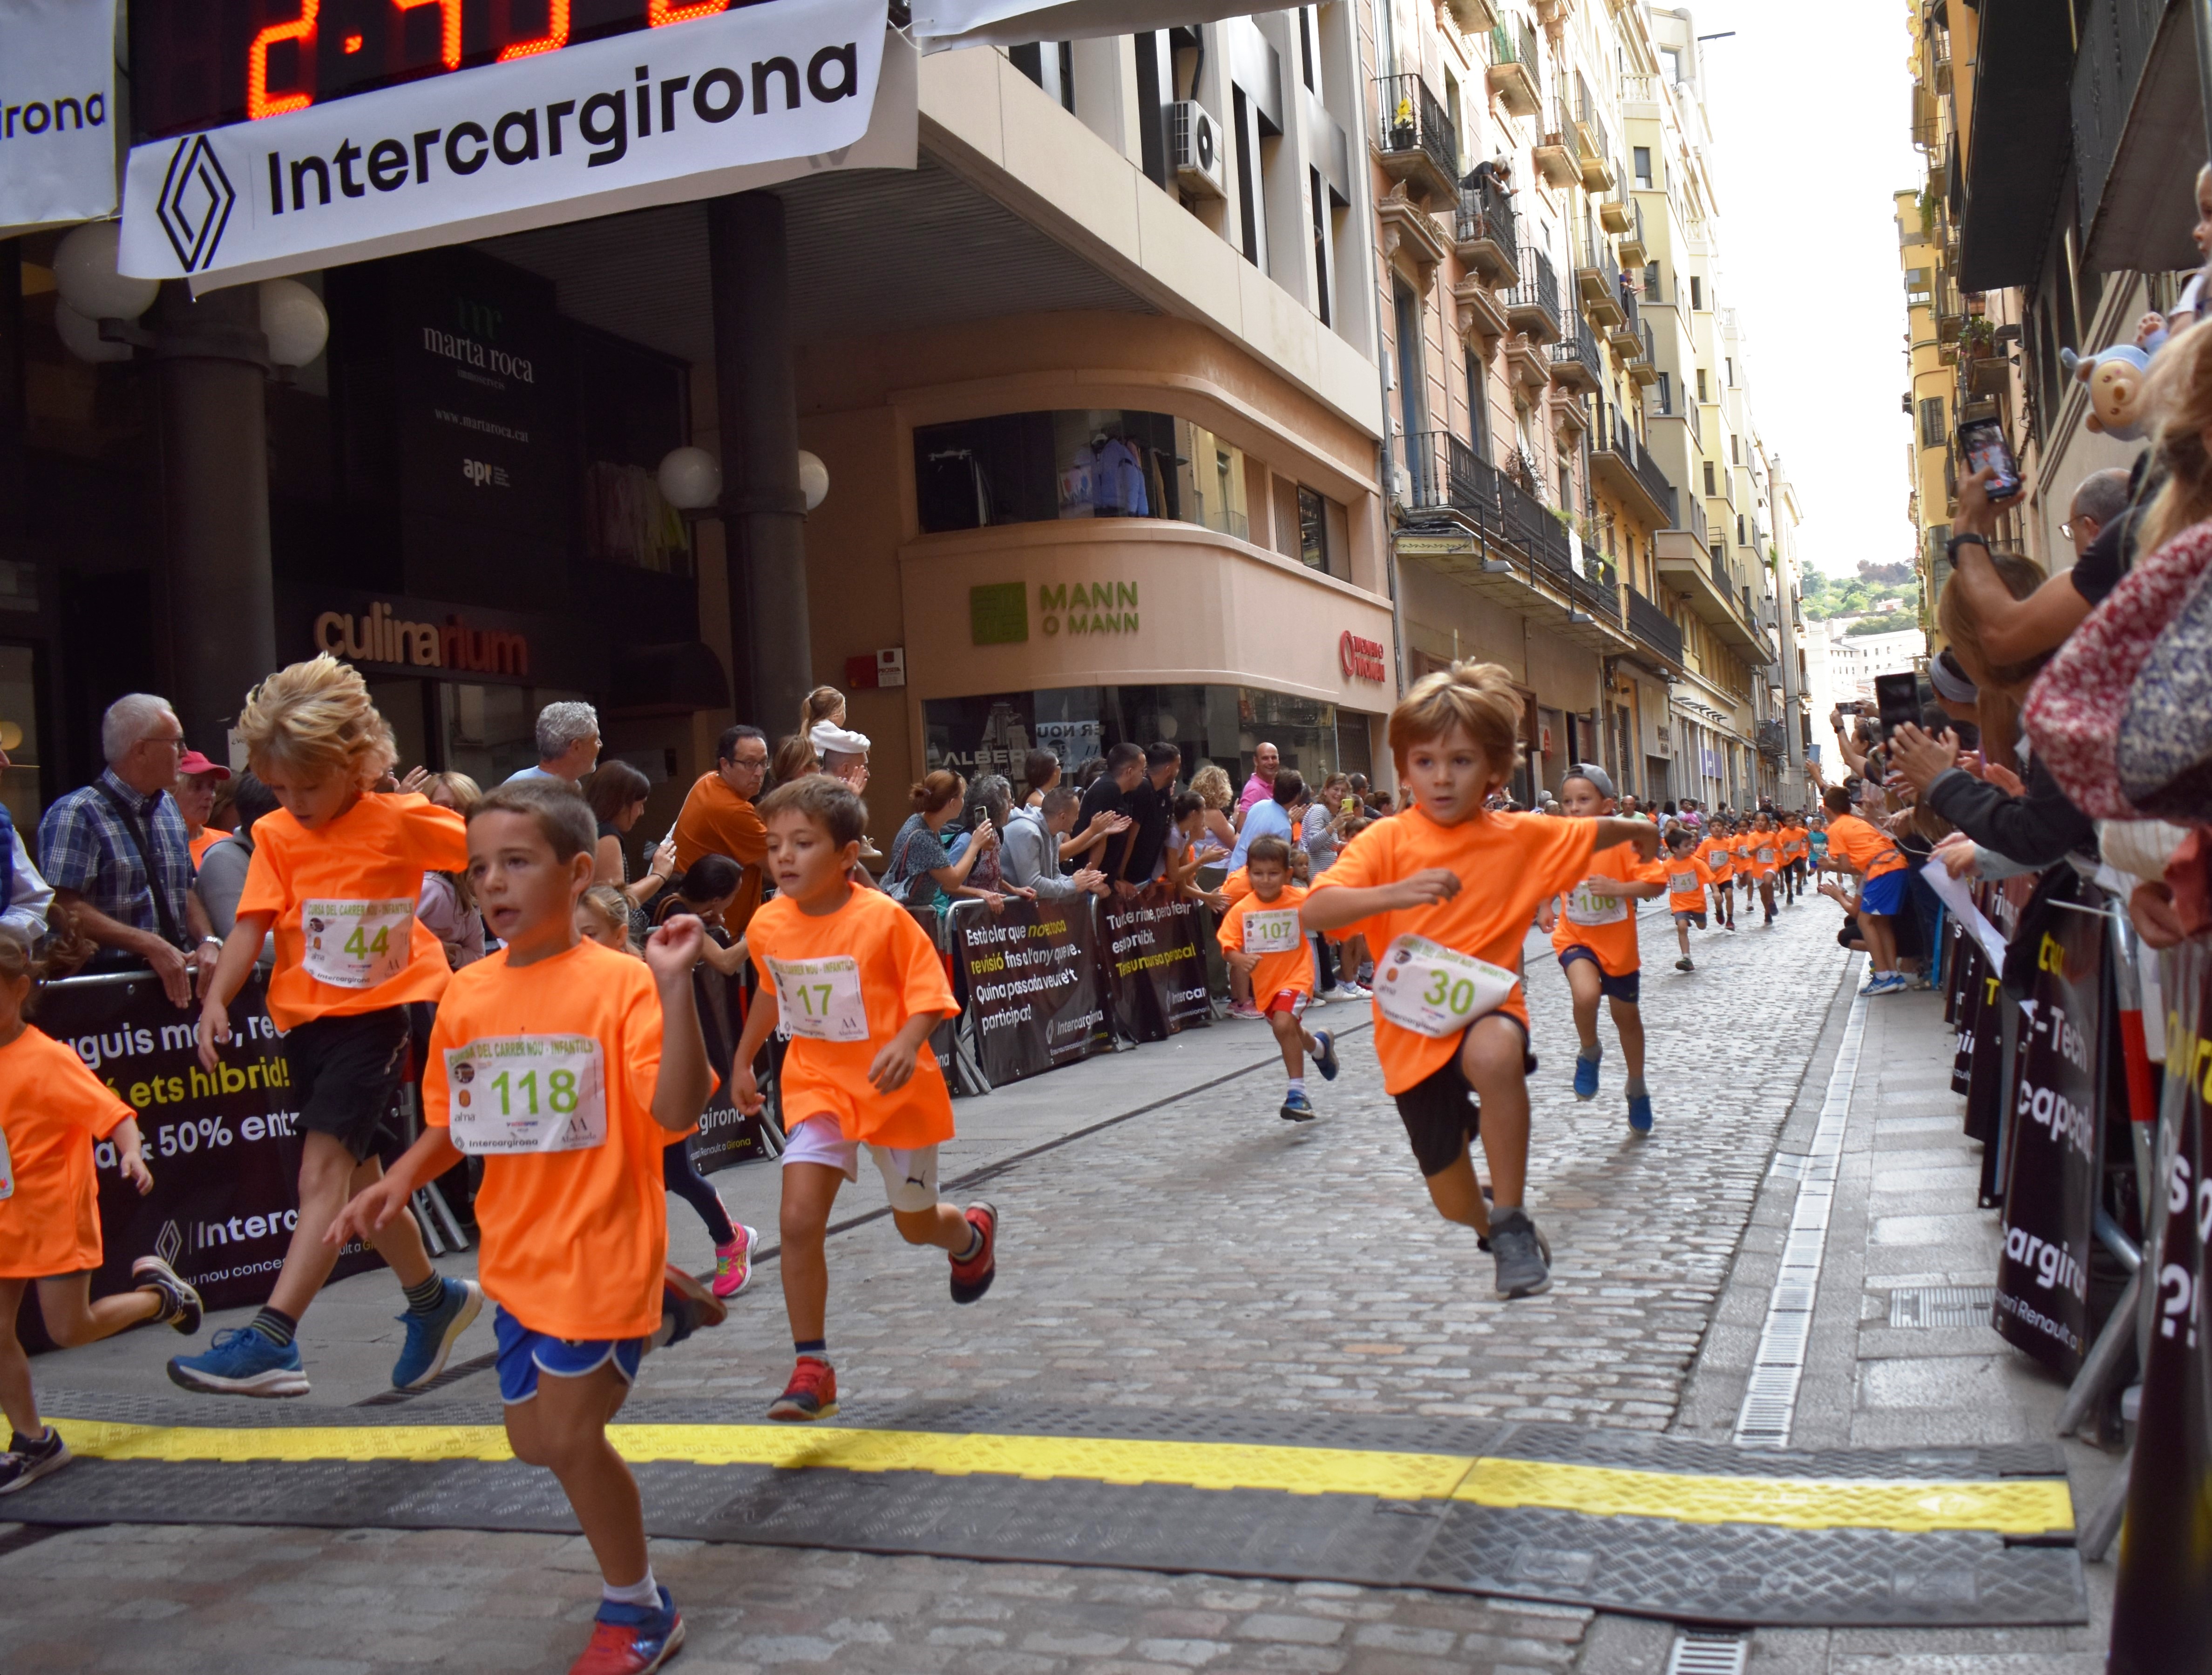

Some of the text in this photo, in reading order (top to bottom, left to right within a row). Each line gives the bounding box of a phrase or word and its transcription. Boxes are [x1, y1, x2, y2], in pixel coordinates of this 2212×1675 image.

[0, 92, 105, 141] rona
[268, 42, 858, 216] Intercargirona
[423, 327, 535, 384] marta roca
[456, 365, 506, 391] immoserveis
[434, 408, 529, 443] www.martaroca.cat
[1040, 581, 1138, 610] MANN
[1042, 612, 1139, 635] O MANN
[314, 601, 529, 676] culinarium
[1156, 903, 1172, 922] però
[344, 925, 390, 960] 44
[989, 924, 1006, 942] clar
[1008, 925, 1027, 944] que
[1028, 924, 1045, 937] no
[1259, 920, 1292, 939] 107
[970, 951, 1004, 975] revisió
[797, 984, 833, 1016] 17
[976, 982, 1006, 1005] Quina
[1424, 968, 1476, 1016] 30
[476, 1043, 492, 1058] DEL
[526, 1042, 543, 1057] NOU
[129, 1074, 185, 1108] ets
[491, 1068, 578, 1116] 118
[454, 1112, 475, 1123] alma
[159, 1115, 233, 1157] 50%
[468, 1138, 538, 1149] Intercargirona
[700, 1143, 722, 1156] Renault
[726, 1138, 752, 1150] Girona
[197, 1208, 300, 1249] Interc
[354, 1243, 361, 1252] a
[200, 1267, 230, 1285] nou
[2017, 1301, 2070, 1345] Renault
